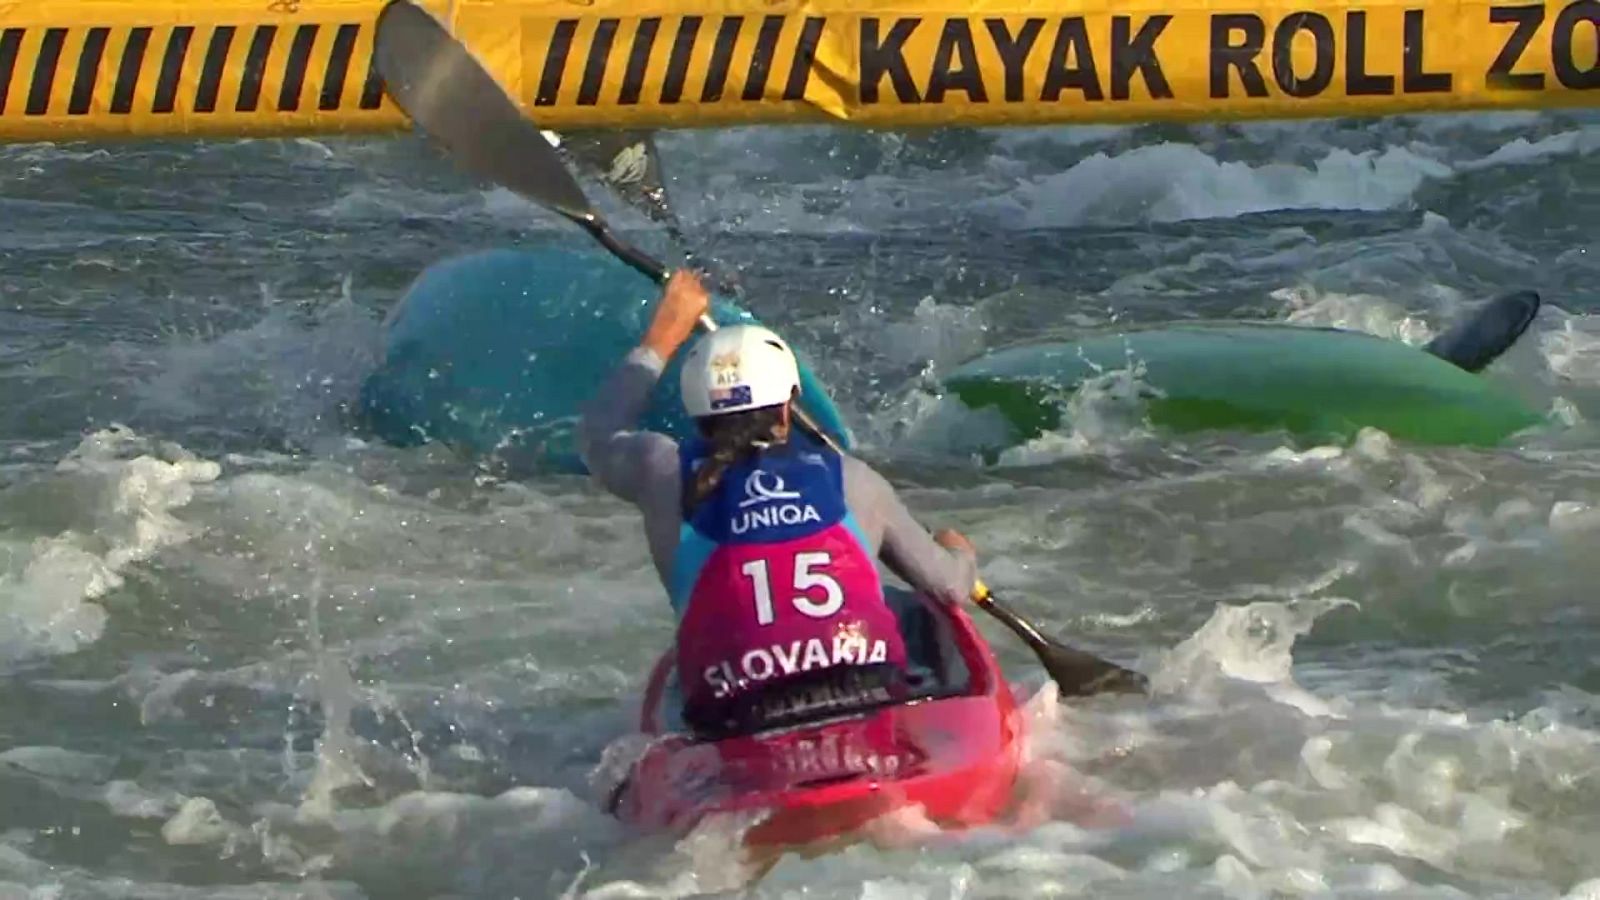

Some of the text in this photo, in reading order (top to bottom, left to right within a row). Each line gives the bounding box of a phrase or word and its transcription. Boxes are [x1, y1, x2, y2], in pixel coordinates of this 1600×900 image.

[859, 16, 1174, 103] KAYAK
[1209, 11, 1452, 98] ROLL
[731, 504, 820, 534] UNIQA
[742, 552, 844, 626] 15
[704, 638, 888, 698] SLOVAKIA
